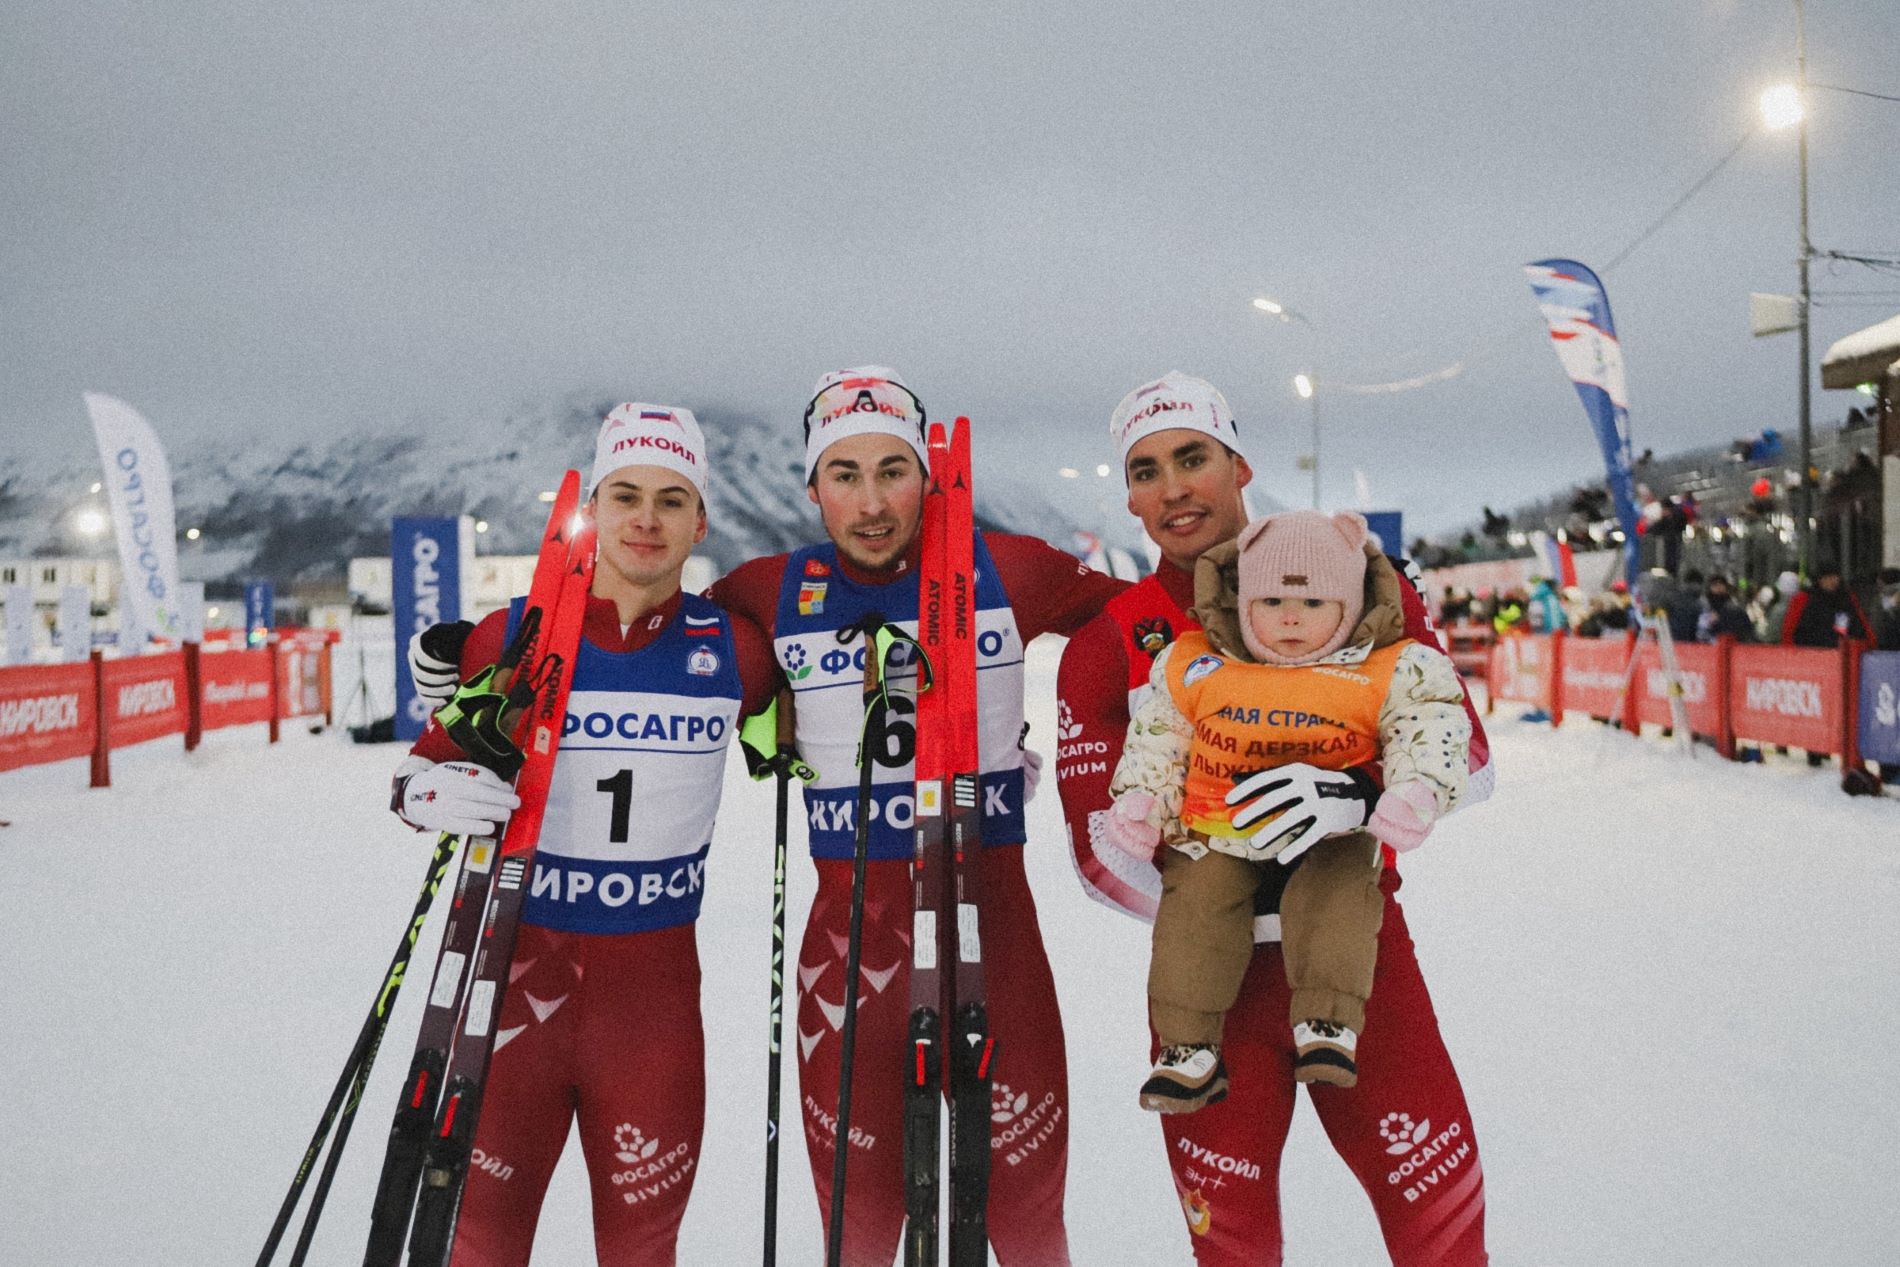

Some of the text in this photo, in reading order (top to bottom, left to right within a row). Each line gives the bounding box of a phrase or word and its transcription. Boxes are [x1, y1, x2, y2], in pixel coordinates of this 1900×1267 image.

[612, 435, 696, 465] ЛУКОЙЛ
[927, 578, 941, 646] ATOMIC
[953, 571, 967, 640] ATOMIC
[868, 695, 917, 768] 6
[1245, 730, 1358, 758] ДЕРЗКАЯ
[597, 768, 634, 844] 1
[991, 1091, 1055, 1149] ФОСАГРО
[1005, 1106, 1063, 1167] BIVIUM
[611, 1142, 689, 1186] ФОСАГРО
[623, 1157, 695, 1205] BIVIUM
[1177, 1136, 1261, 1180] ЛУКОЙЛ
[1388, 1121, 1461, 1185] ФОСАГРО
[1403, 1140, 1470, 1203] BIVIUM
